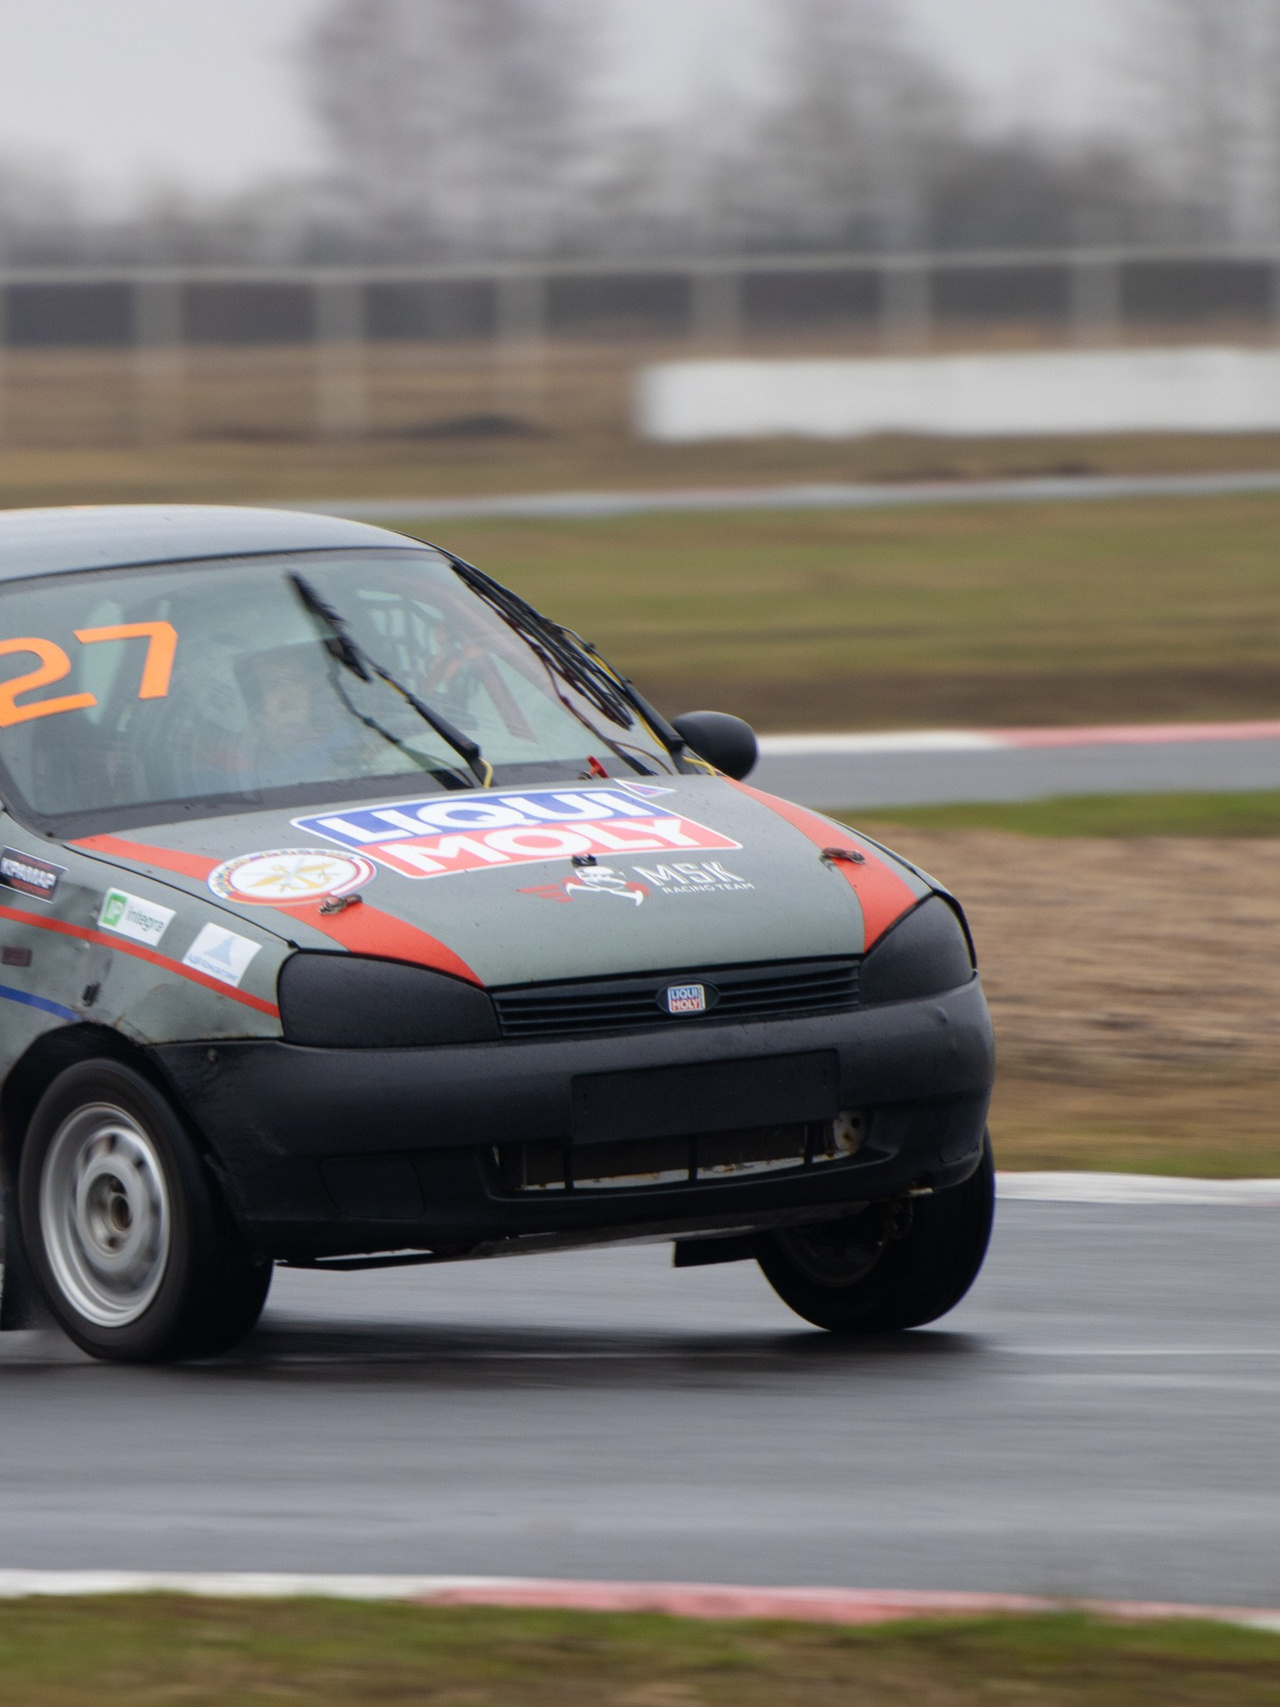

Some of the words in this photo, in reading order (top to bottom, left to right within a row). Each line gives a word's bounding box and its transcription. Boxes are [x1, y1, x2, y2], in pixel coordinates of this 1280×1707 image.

[317, 792, 655, 844] LIQUI
[378, 817, 701, 873] MOLY
[631, 861, 746, 887] MSK
[661, 884, 718, 895] RACING
[719, 882, 756, 892] TEAM
[671, 987, 699, 1000] LIQUI
[672, 999, 700, 1011] MOLY
